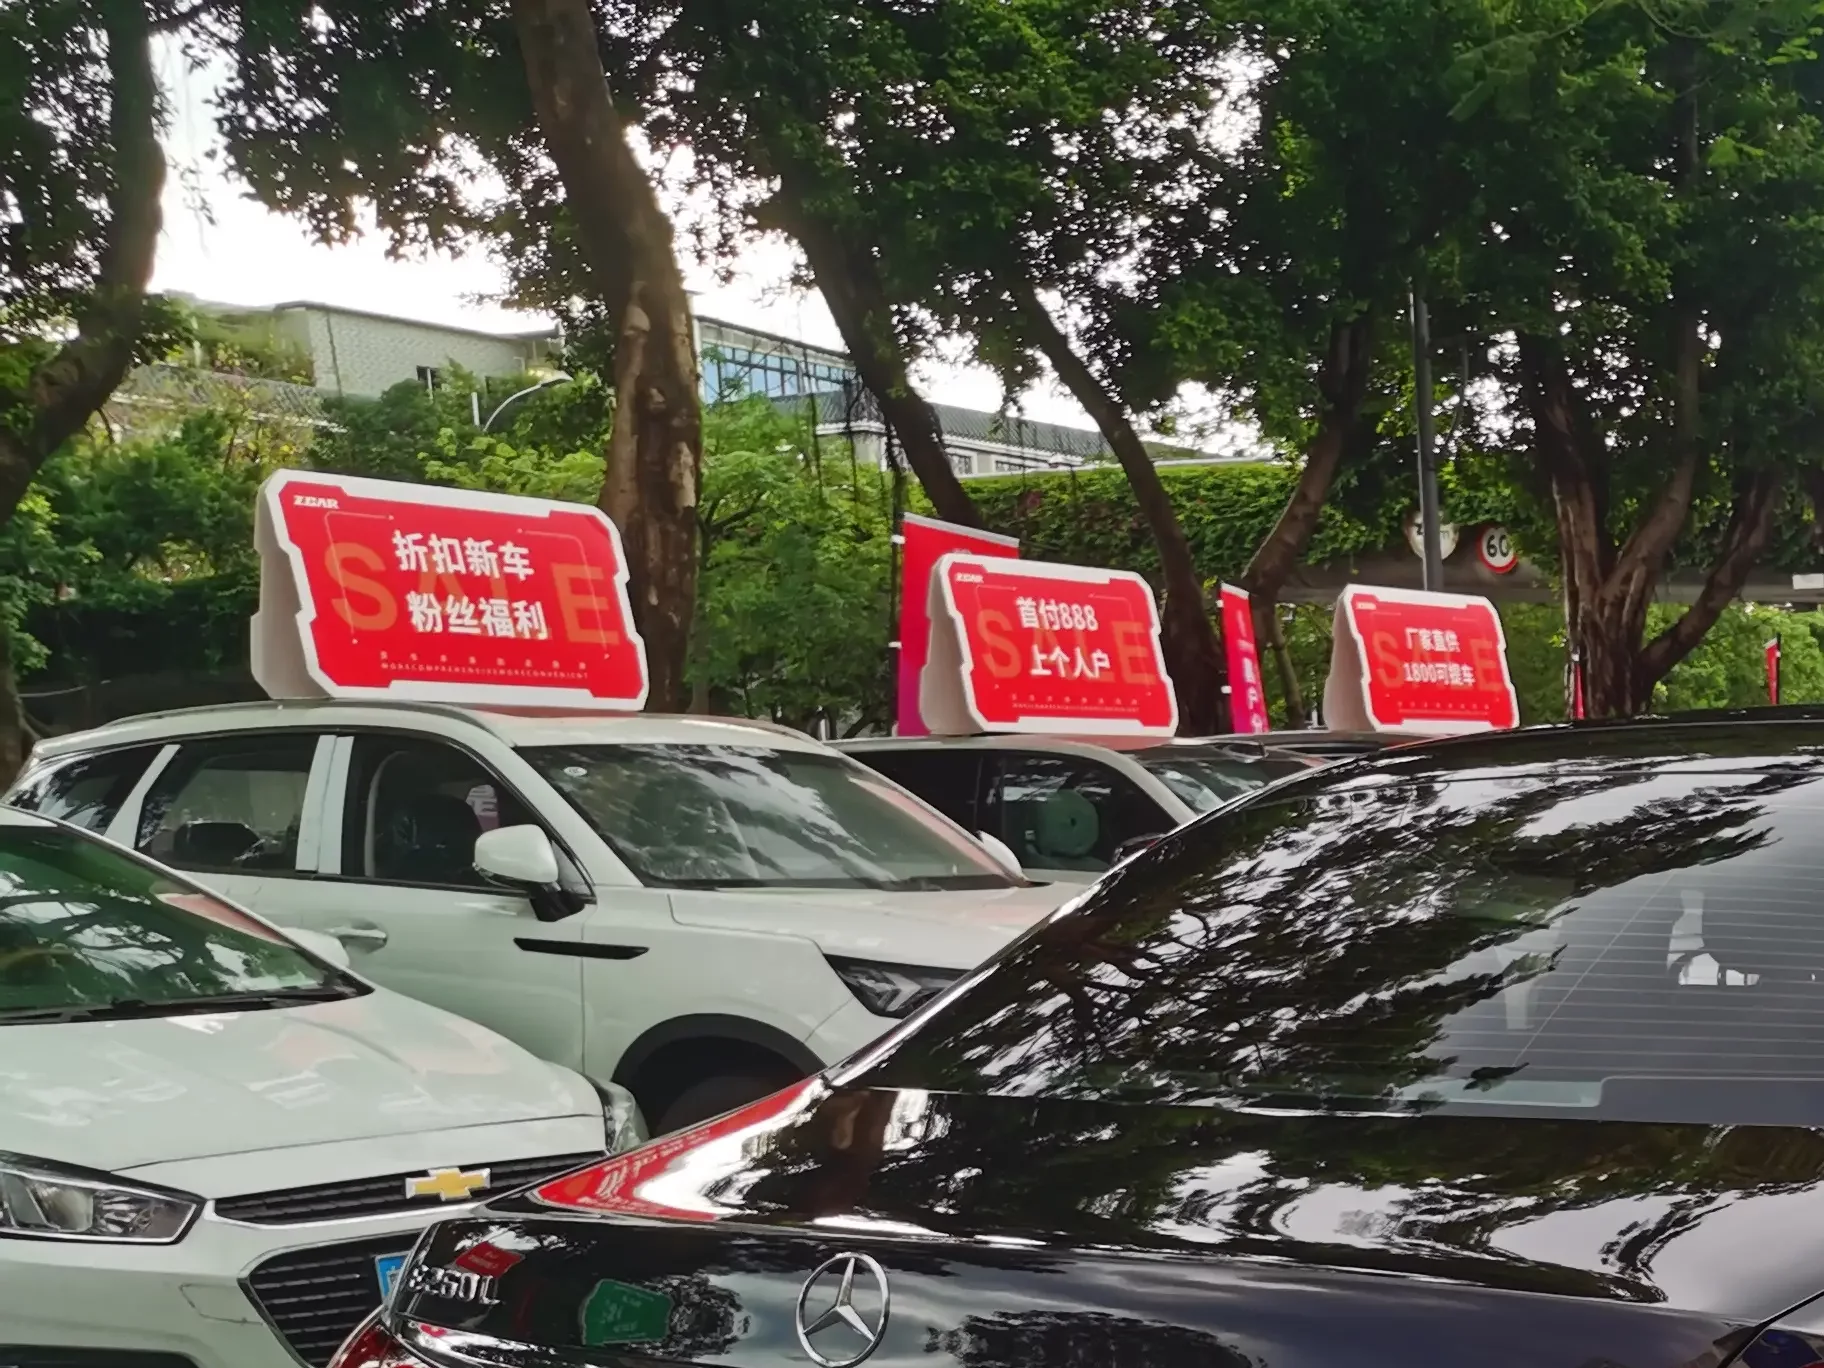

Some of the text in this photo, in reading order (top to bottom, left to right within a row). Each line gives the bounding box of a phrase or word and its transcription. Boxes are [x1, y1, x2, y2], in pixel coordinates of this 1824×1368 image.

[392, 529, 535, 581] 折扣新车
[1486, 534, 1510, 558] 60
[405, 590, 549, 641] 粉丝福利
[1015, 596, 1099, 631] 首付888
[1030, 644, 1111, 679] 上个人户
